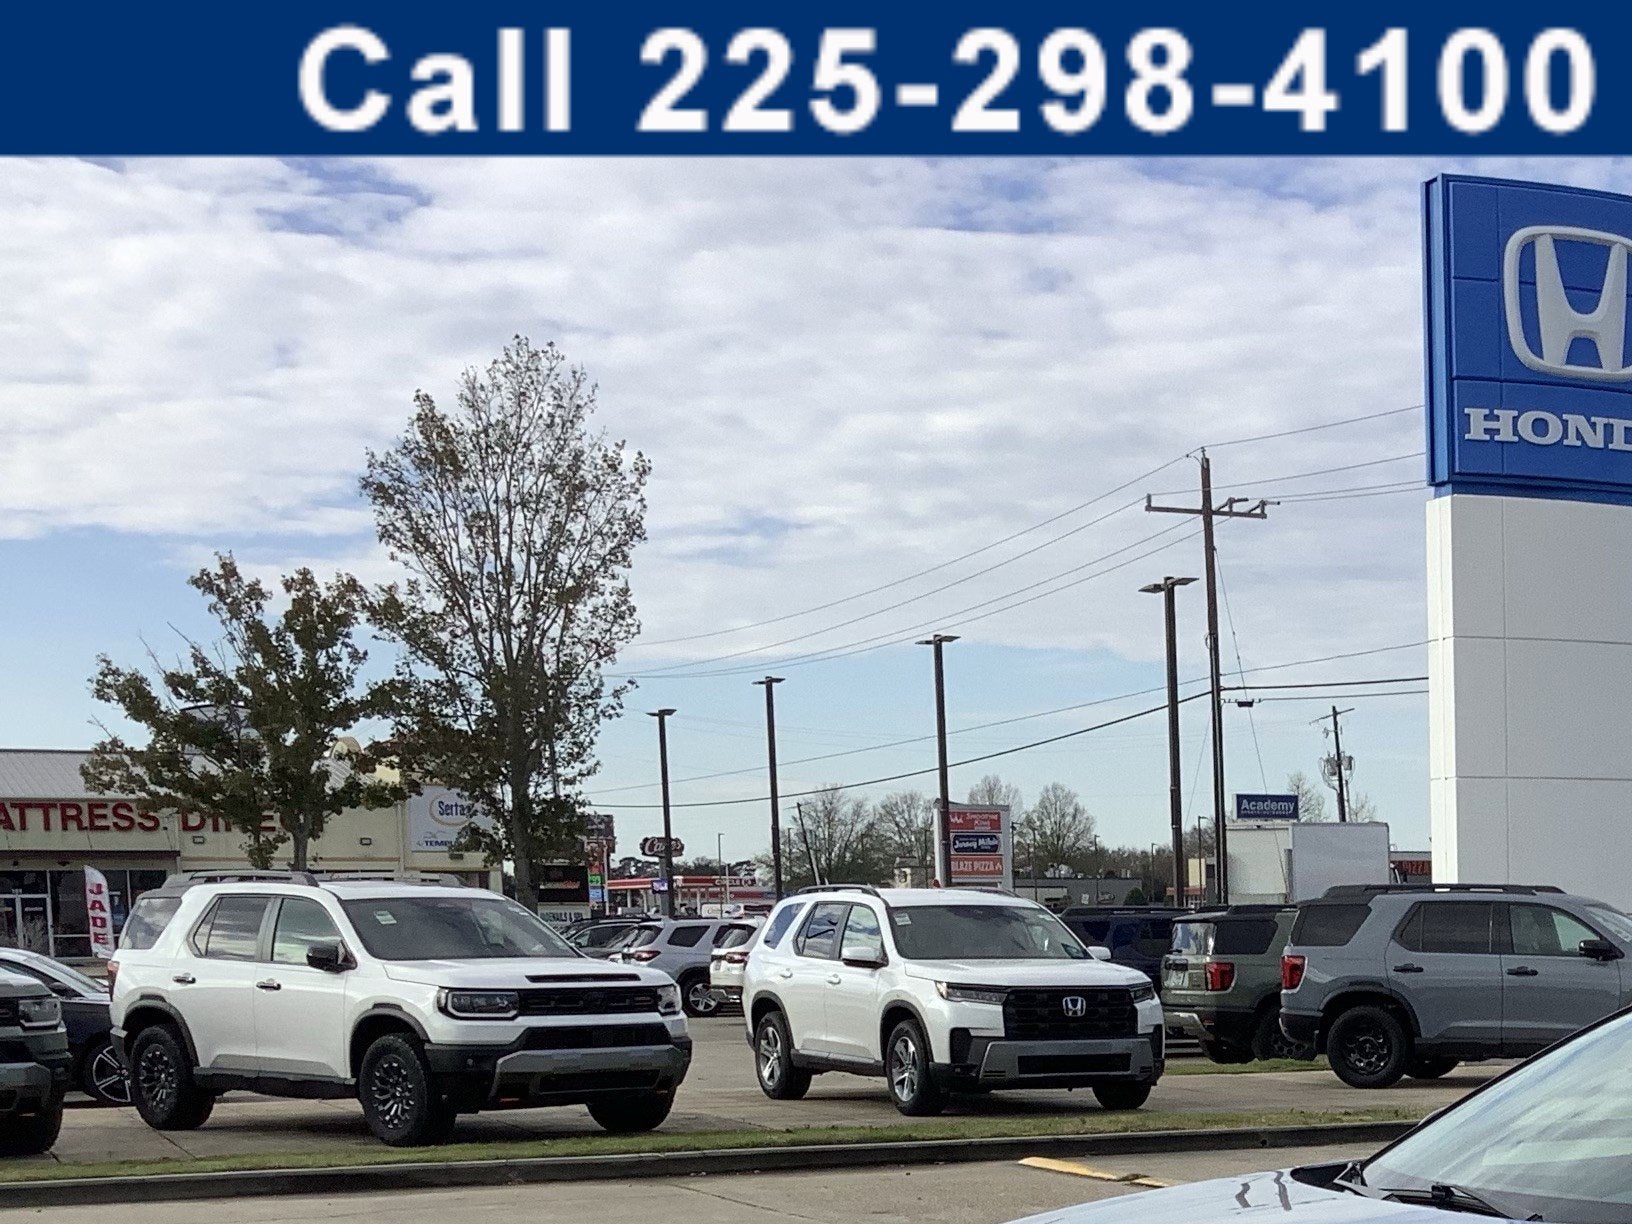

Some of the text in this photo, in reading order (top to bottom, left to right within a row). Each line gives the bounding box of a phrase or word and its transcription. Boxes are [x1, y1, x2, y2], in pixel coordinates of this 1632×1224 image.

[438, 800, 465, 816] Serta
[1241, 799, 1295, 812] Academy
[974, 861, 994, 872] PIZZA
[88, 883, 109, 946] JADE
